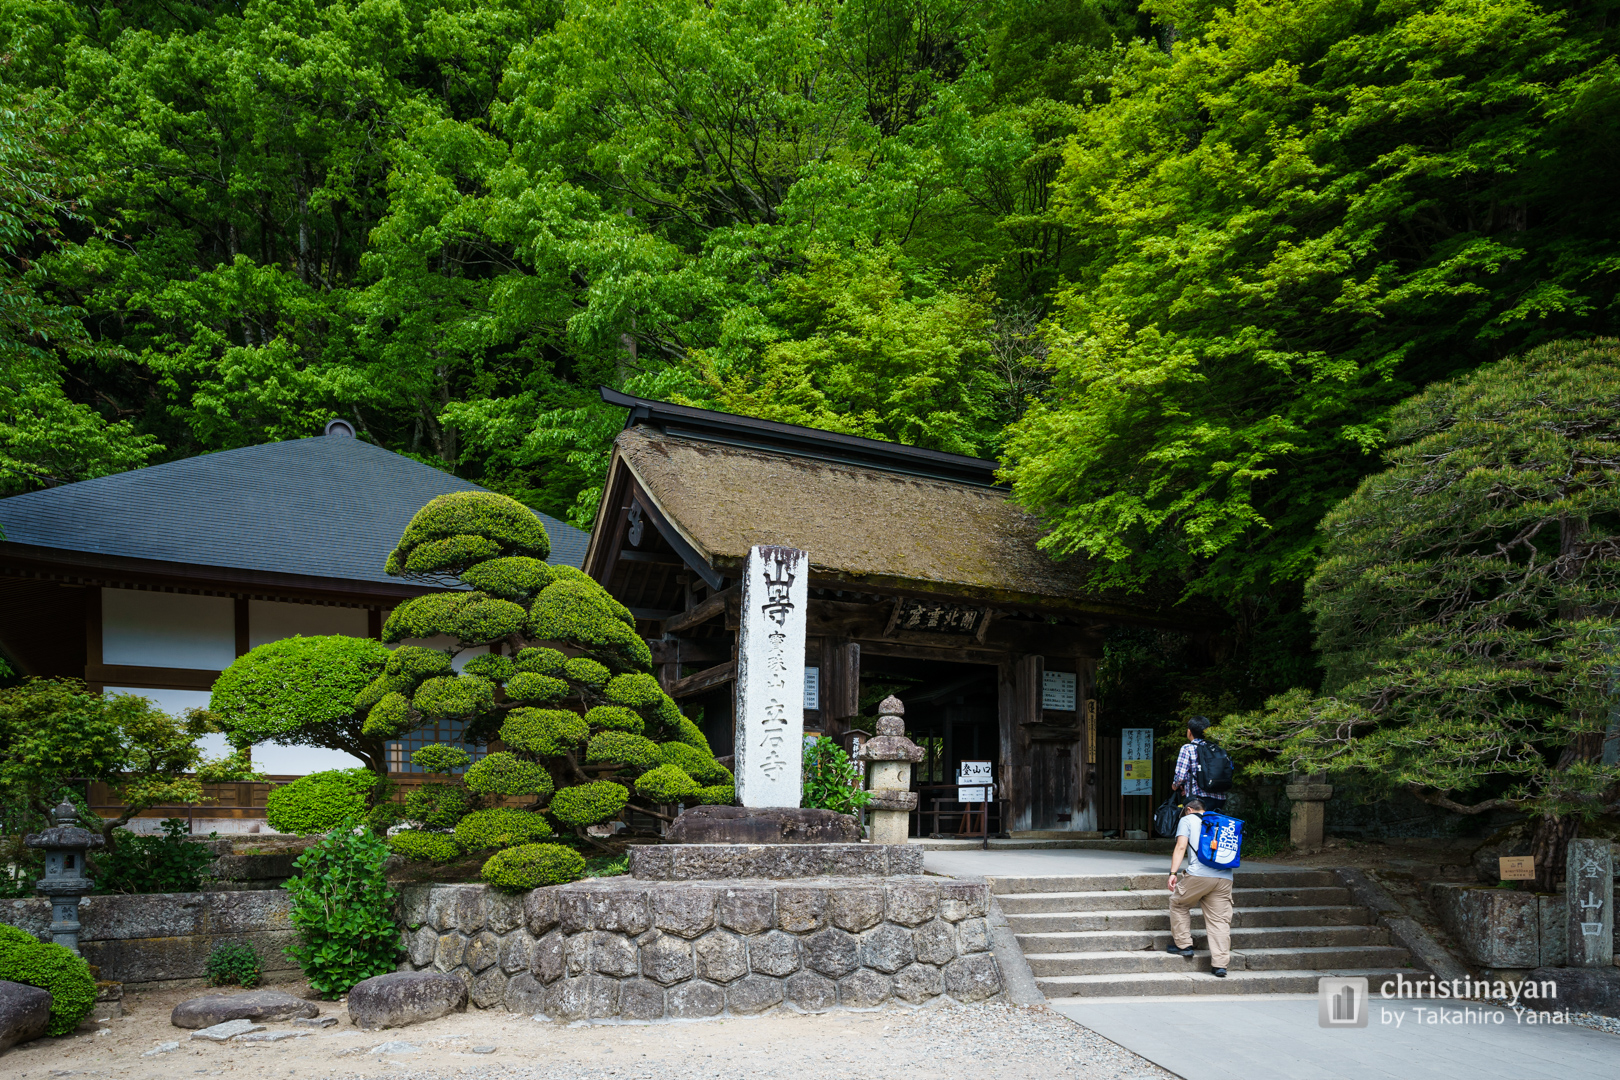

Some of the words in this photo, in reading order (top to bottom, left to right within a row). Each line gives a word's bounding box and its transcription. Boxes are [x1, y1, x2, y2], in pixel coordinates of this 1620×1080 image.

[762, 559, 796, 627] 山寺
[760, 698, 788, 782] 立石寺
[962, 763, 992, 776] 登山口
[1218, 825, 1229, 849] FACE
[1225, 819, 1236, 851] NORTH
[1579, 857, 1606, 937] 登山口
